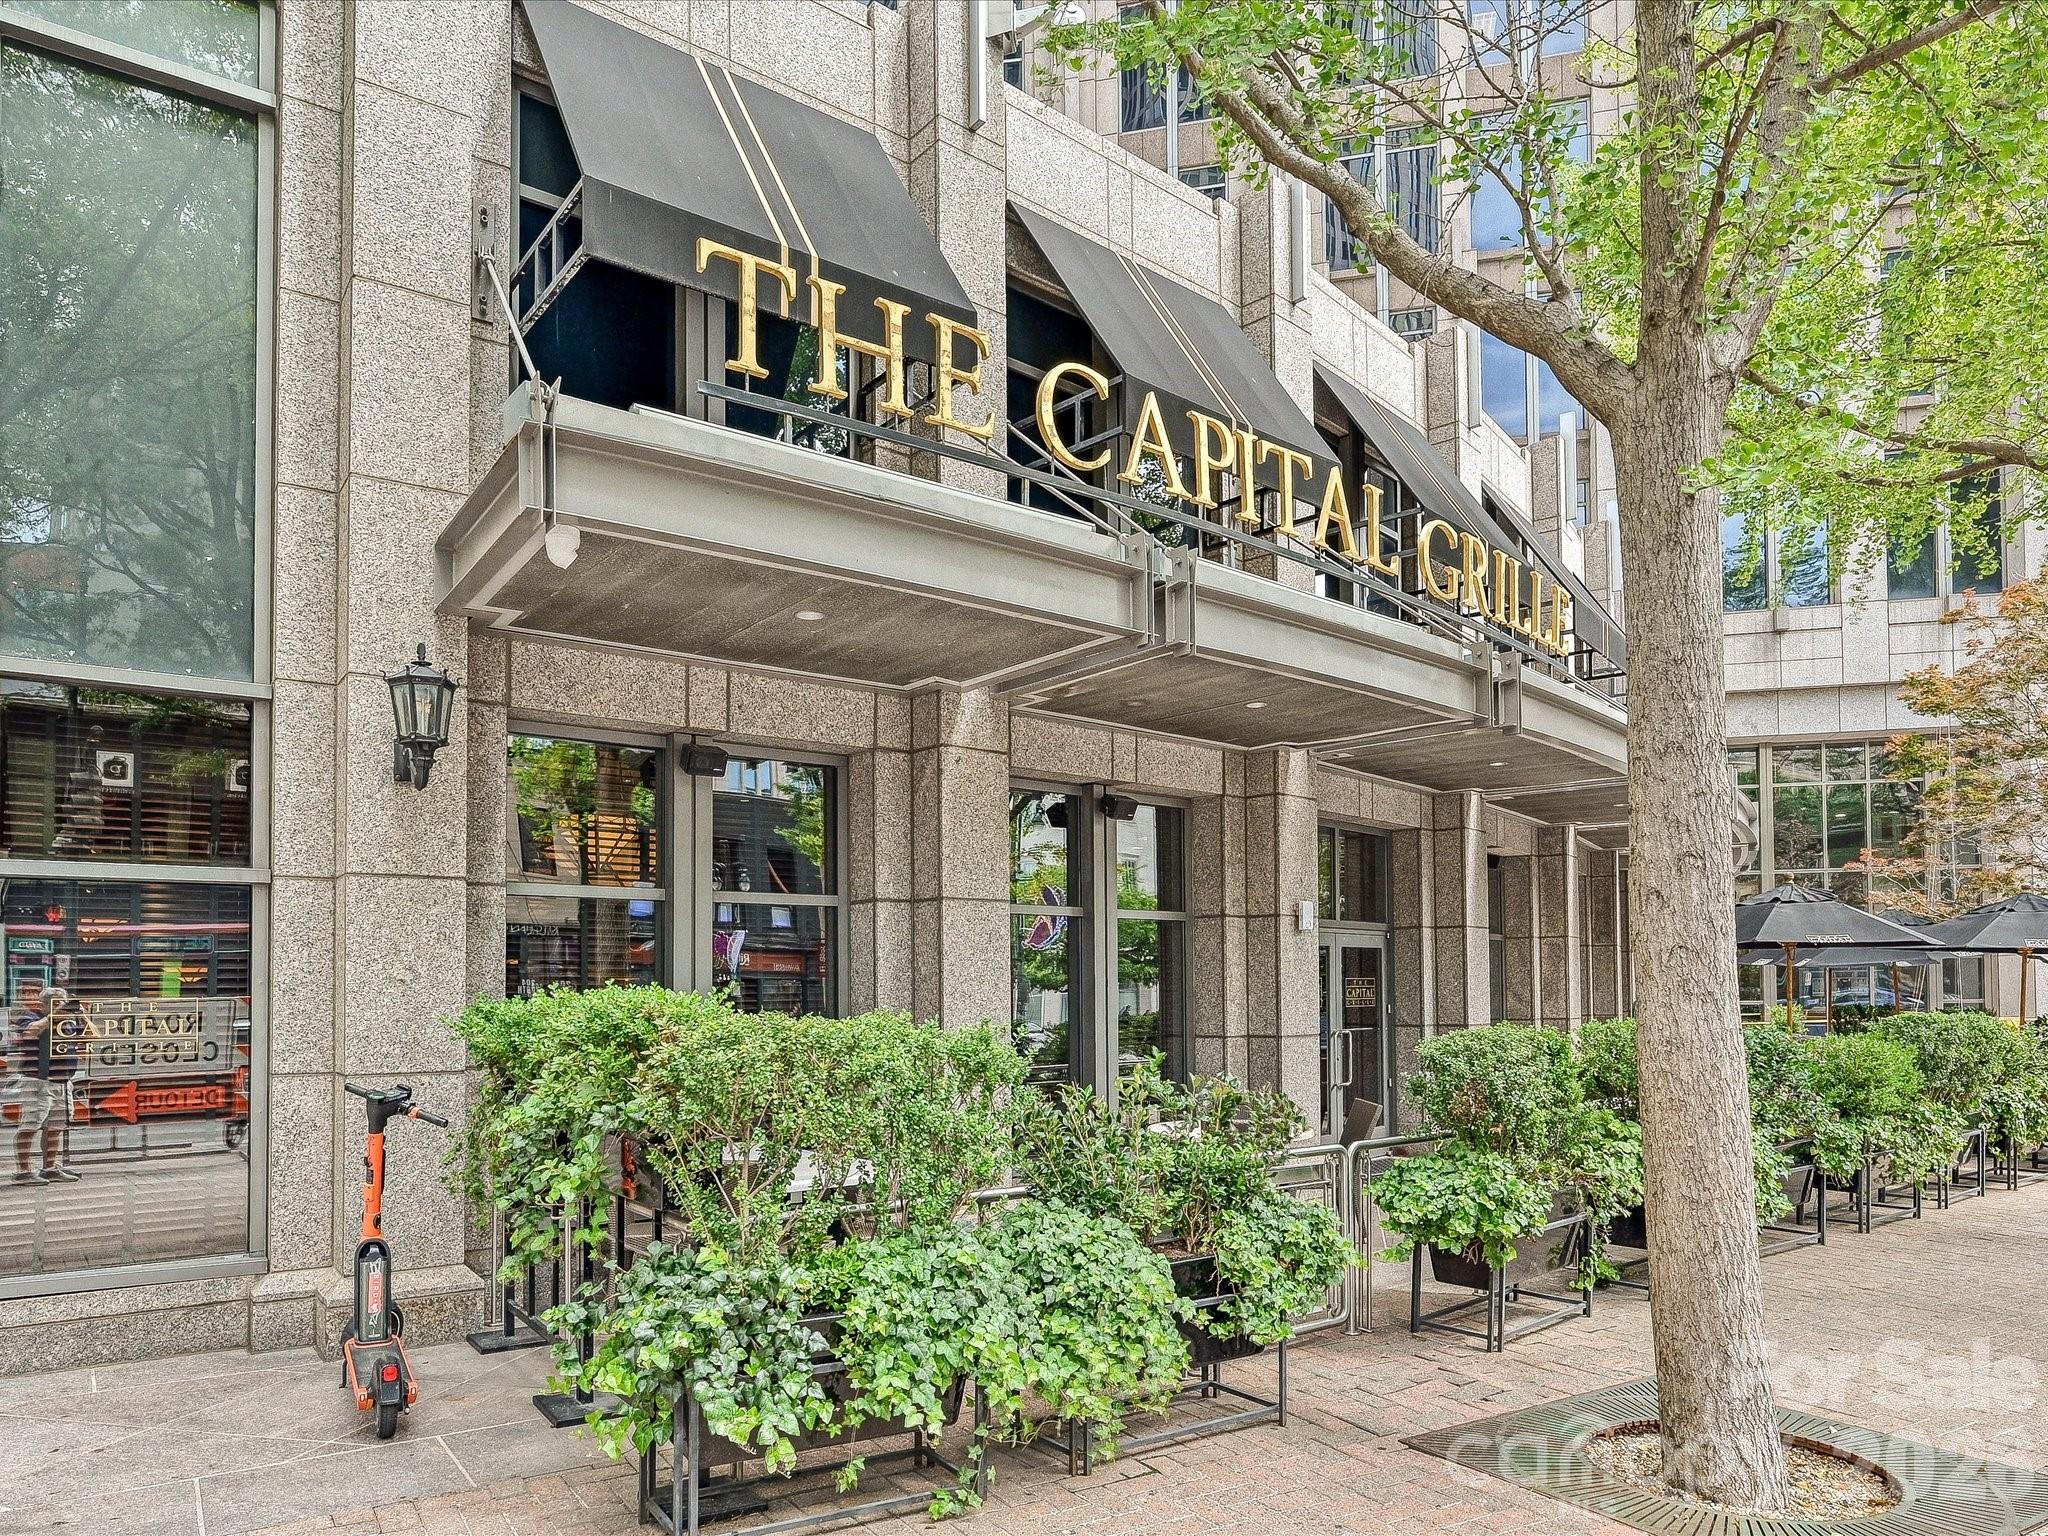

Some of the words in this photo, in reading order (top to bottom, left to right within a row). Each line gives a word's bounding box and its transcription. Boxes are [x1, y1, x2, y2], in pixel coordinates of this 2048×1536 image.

[695, 236, 995, 440] THE
[1035, 362, 1400, 577] CAPITAL
[1418, 519, 1573, 657] GRILLE
[1346, 988, 1374, 998] CAPITAL
[94, 1002, 159, 1013] THE
[56, 1019, 196, 1038] CAPITAL
